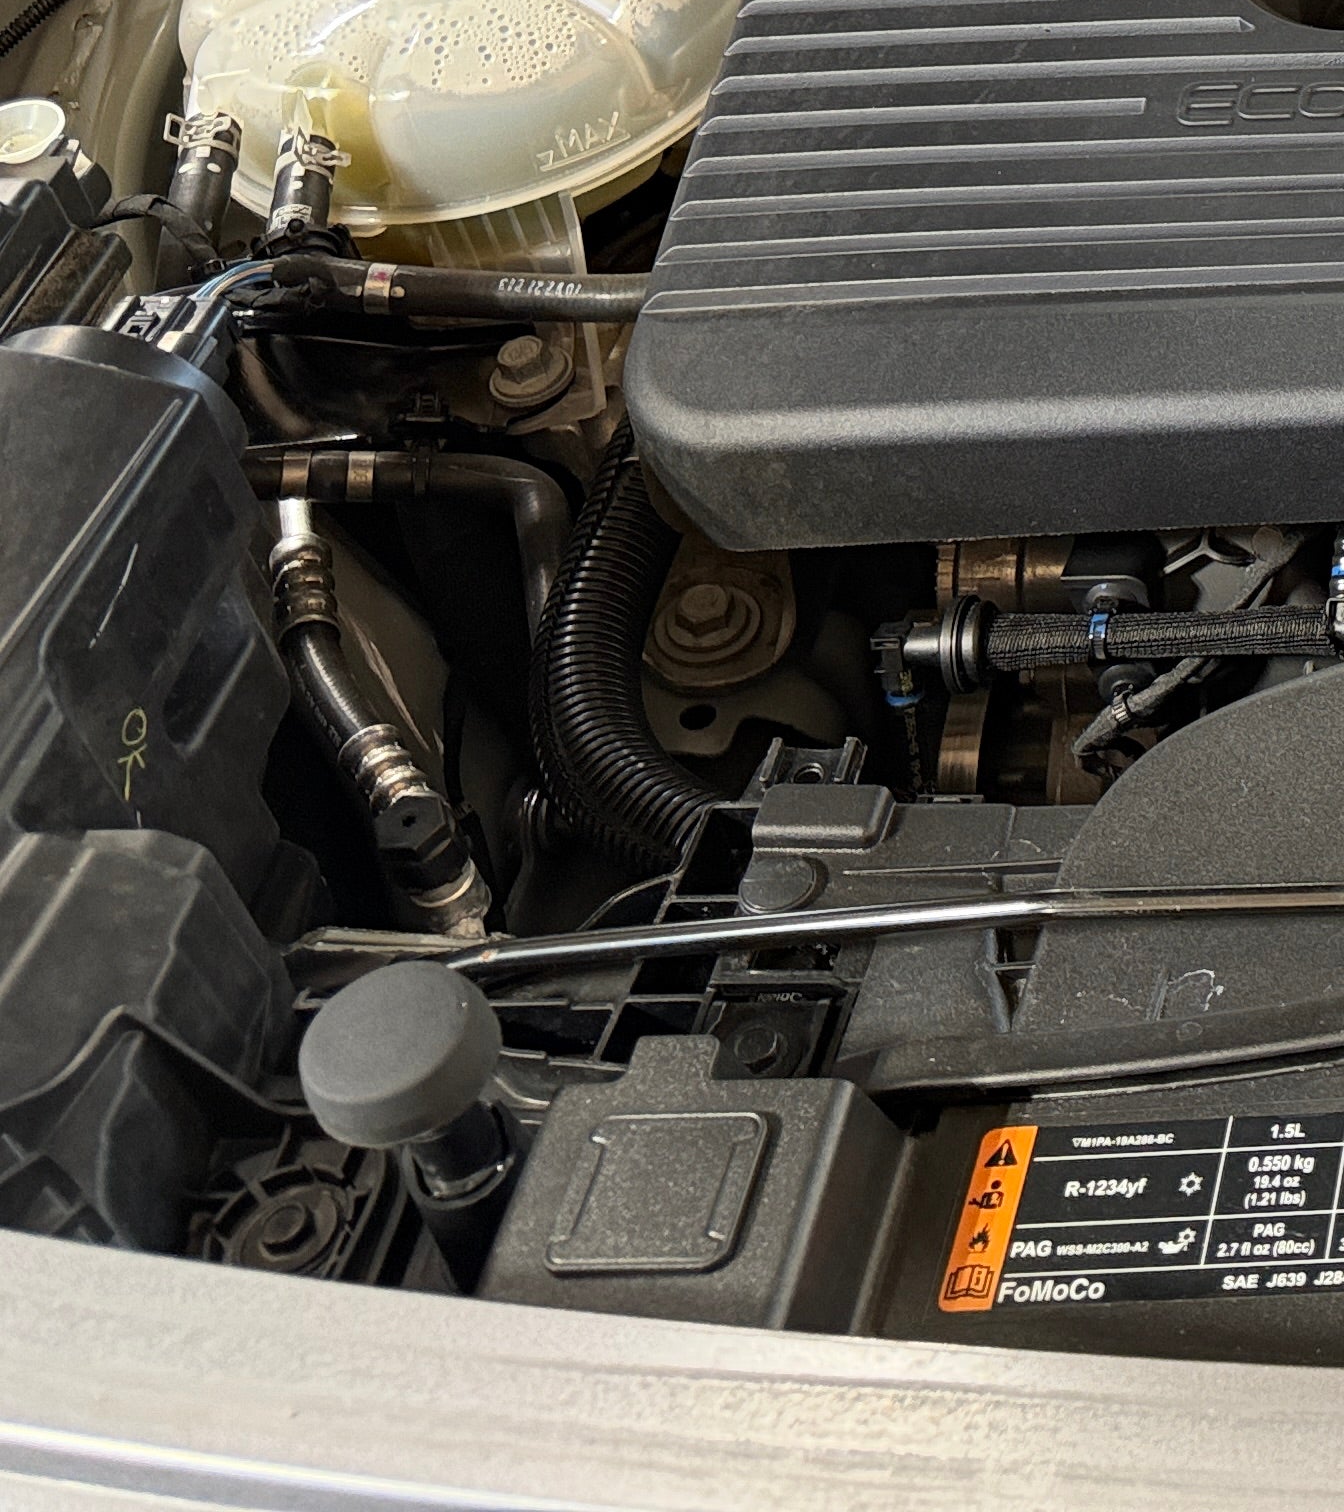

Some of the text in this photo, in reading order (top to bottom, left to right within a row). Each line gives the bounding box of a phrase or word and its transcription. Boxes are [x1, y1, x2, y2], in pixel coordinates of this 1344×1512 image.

[554, 110, 627, 158] MAX
[1270, 1123, 1306, 1139] 1.5L
[1248, 1154, 1315, 1174] 0.550 kg
[1064, 1177, 1148, 1199] R-1234yf
[1253, 1175, 1301, 1189] 19.4 oz
[1244, 1189, 1306, 1210] (1.21 lbs)
[1253, 1222, 1286, 1238] PAG
[1010, 1240, 1053, 1258] PAG
[1216, 1242, 1239, 1258] 2.7
[1253, 1243, 1271, 1255] oz
[1272, 1239, 1316, 1258] (80cc)
[997, 1277, 1106, 1304] FoMoCo
[1221, 1274, 1260, 1290] SAE
[1266, 1272, 1306, 1289] J639
